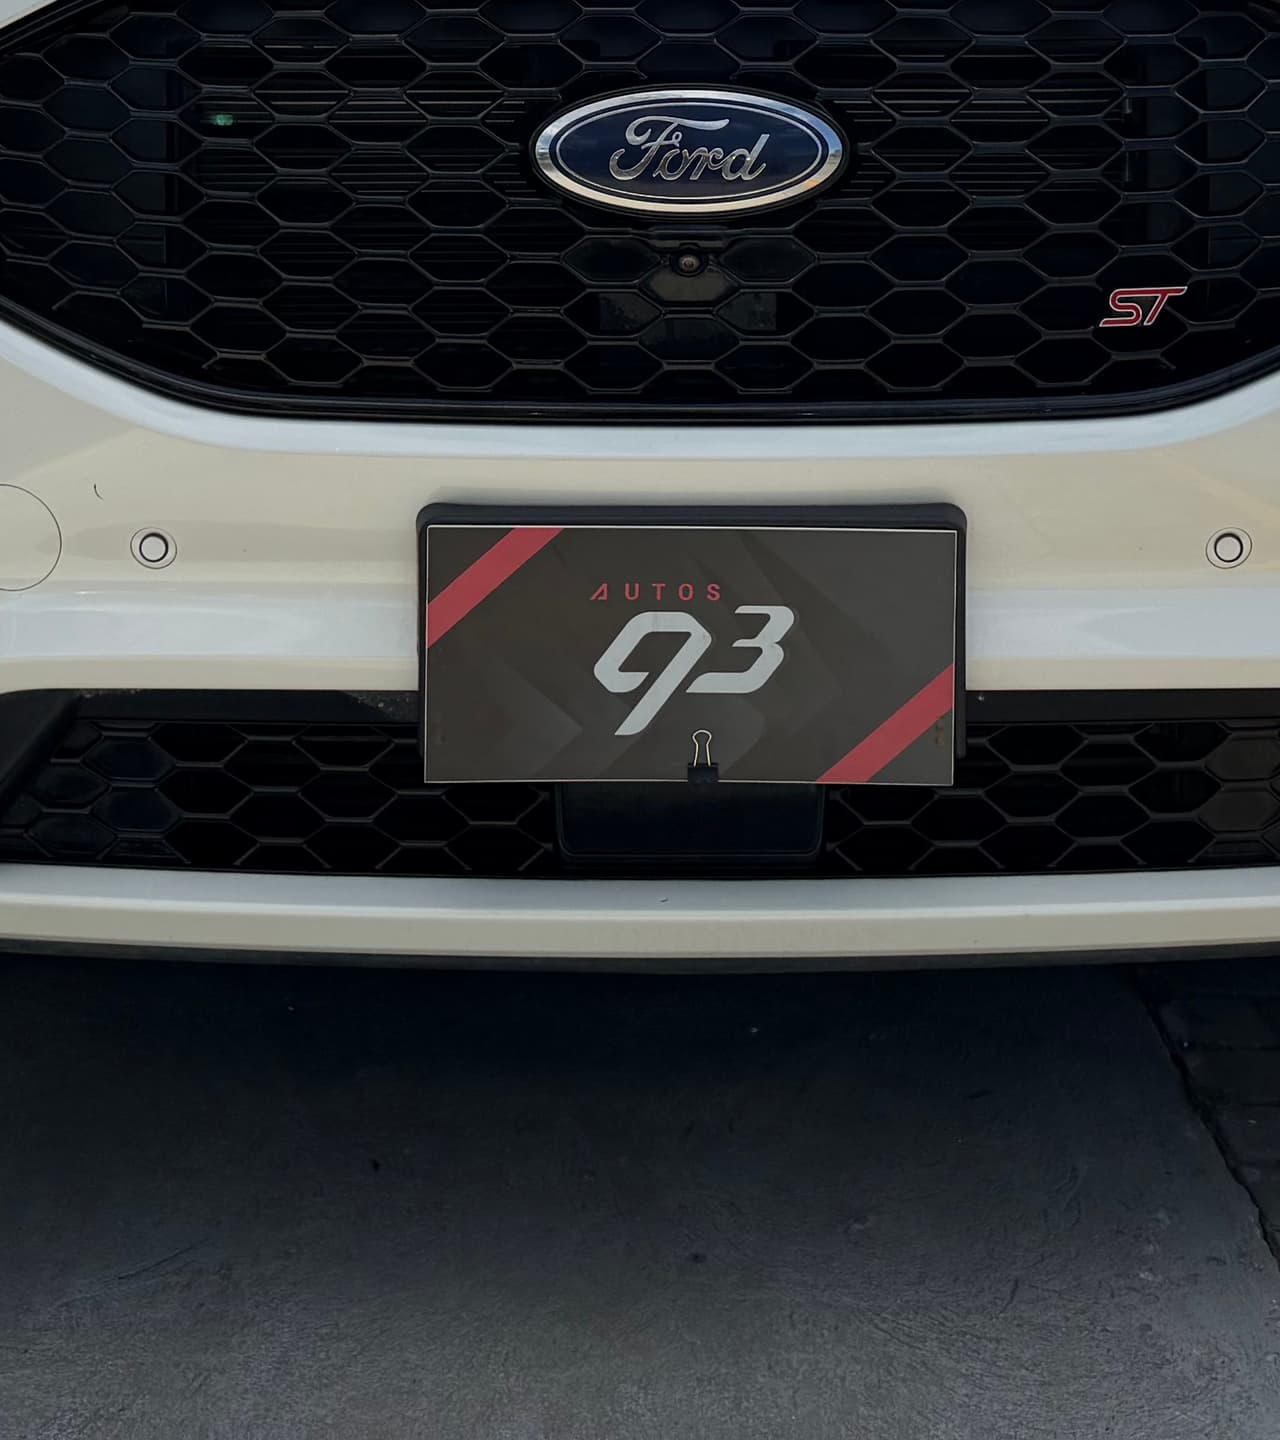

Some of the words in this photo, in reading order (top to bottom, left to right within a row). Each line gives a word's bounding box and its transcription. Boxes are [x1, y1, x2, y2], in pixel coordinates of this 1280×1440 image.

[609, 115, 771, 181] Ford
[1099, 286, 1188, 327] ST
[589, 583, 721, 601] AUTOS
[593, 605, 795, 736] 93
